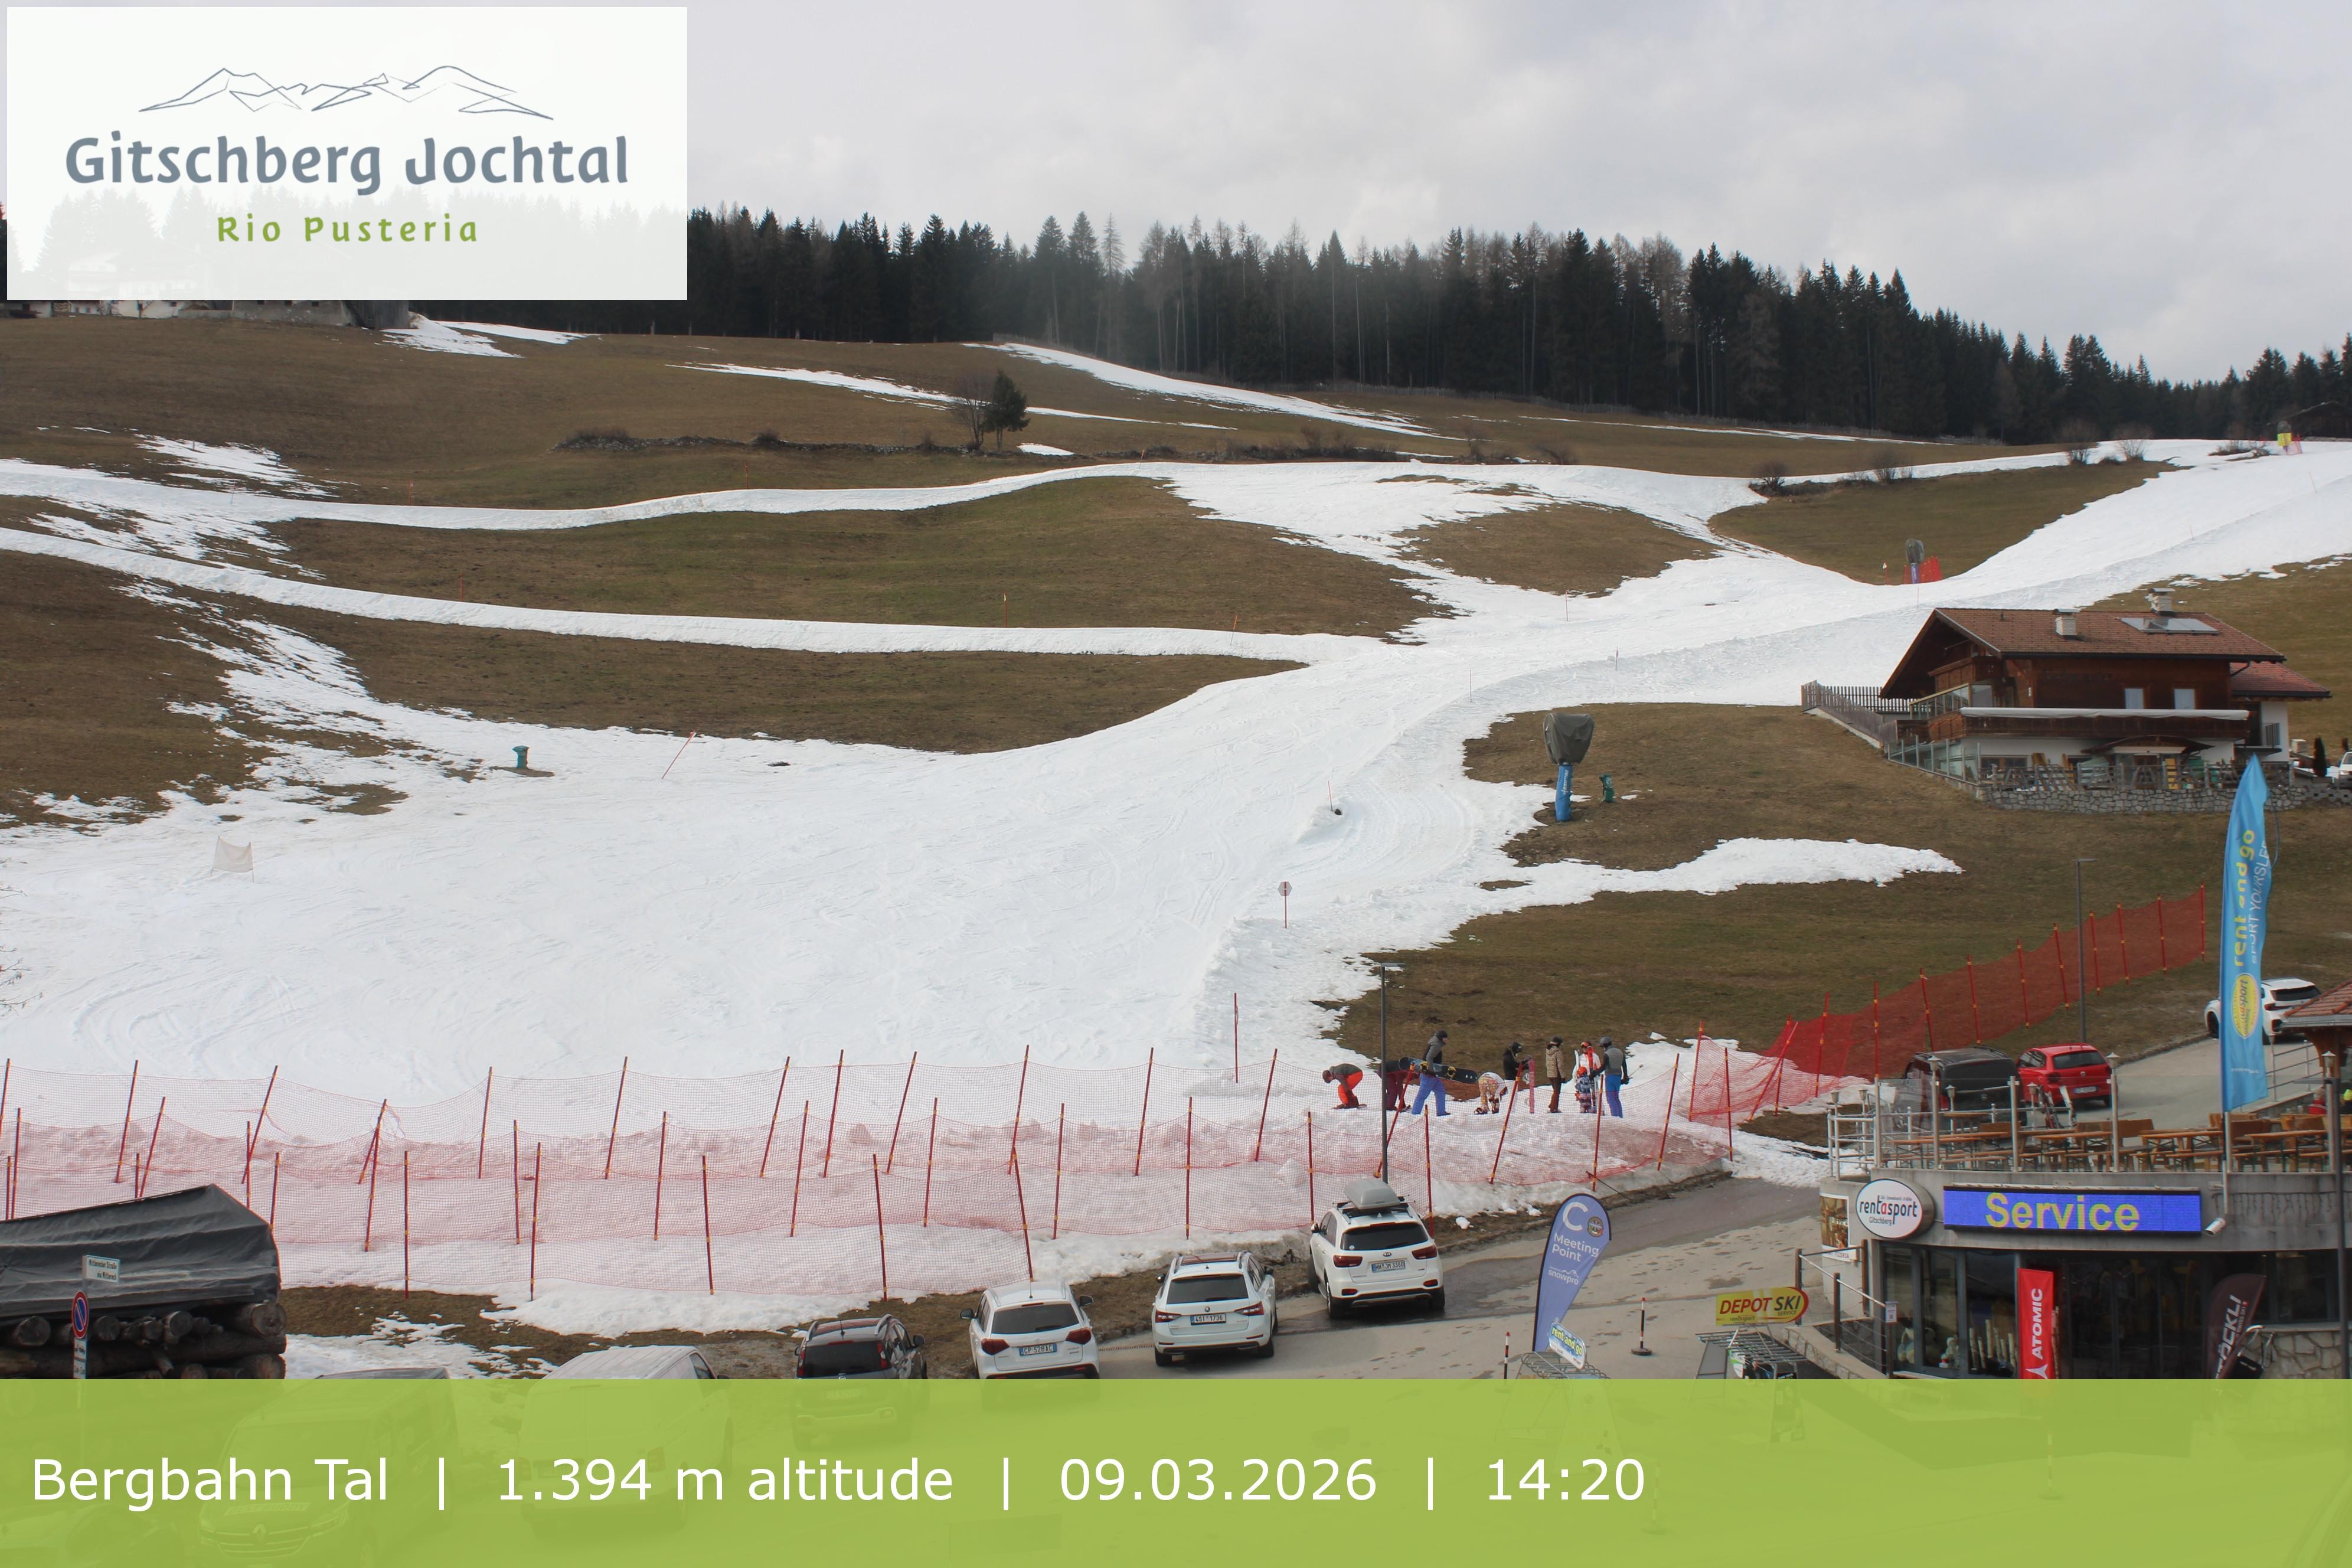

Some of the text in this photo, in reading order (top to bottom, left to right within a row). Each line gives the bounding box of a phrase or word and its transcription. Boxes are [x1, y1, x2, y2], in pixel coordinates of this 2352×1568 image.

[2240, 830, 2255, 861] go
[2234, 915, 2247, 966] rent
[1860, 1195, 1917, 1225] rentasport
[1869, 1216, 1892, 1226] Gitschberg
[1985, 1192, 2141, 1231] Service
[1551, 1243, 1582, 1262] Point
[1554, 1232, 1599, 1257] Meeting
[1548, 1269, 1579, 1285] snowpro
[1720, 1295, 1801, 1315] DEPOT SKI
[2031, 1288, 2043, 1360] ATOMIC
[1551, 1327, 1564, 1341] rent
[1564, 1336, 1575, 1350] and
[1576, 1345, 1583, 1356] go
